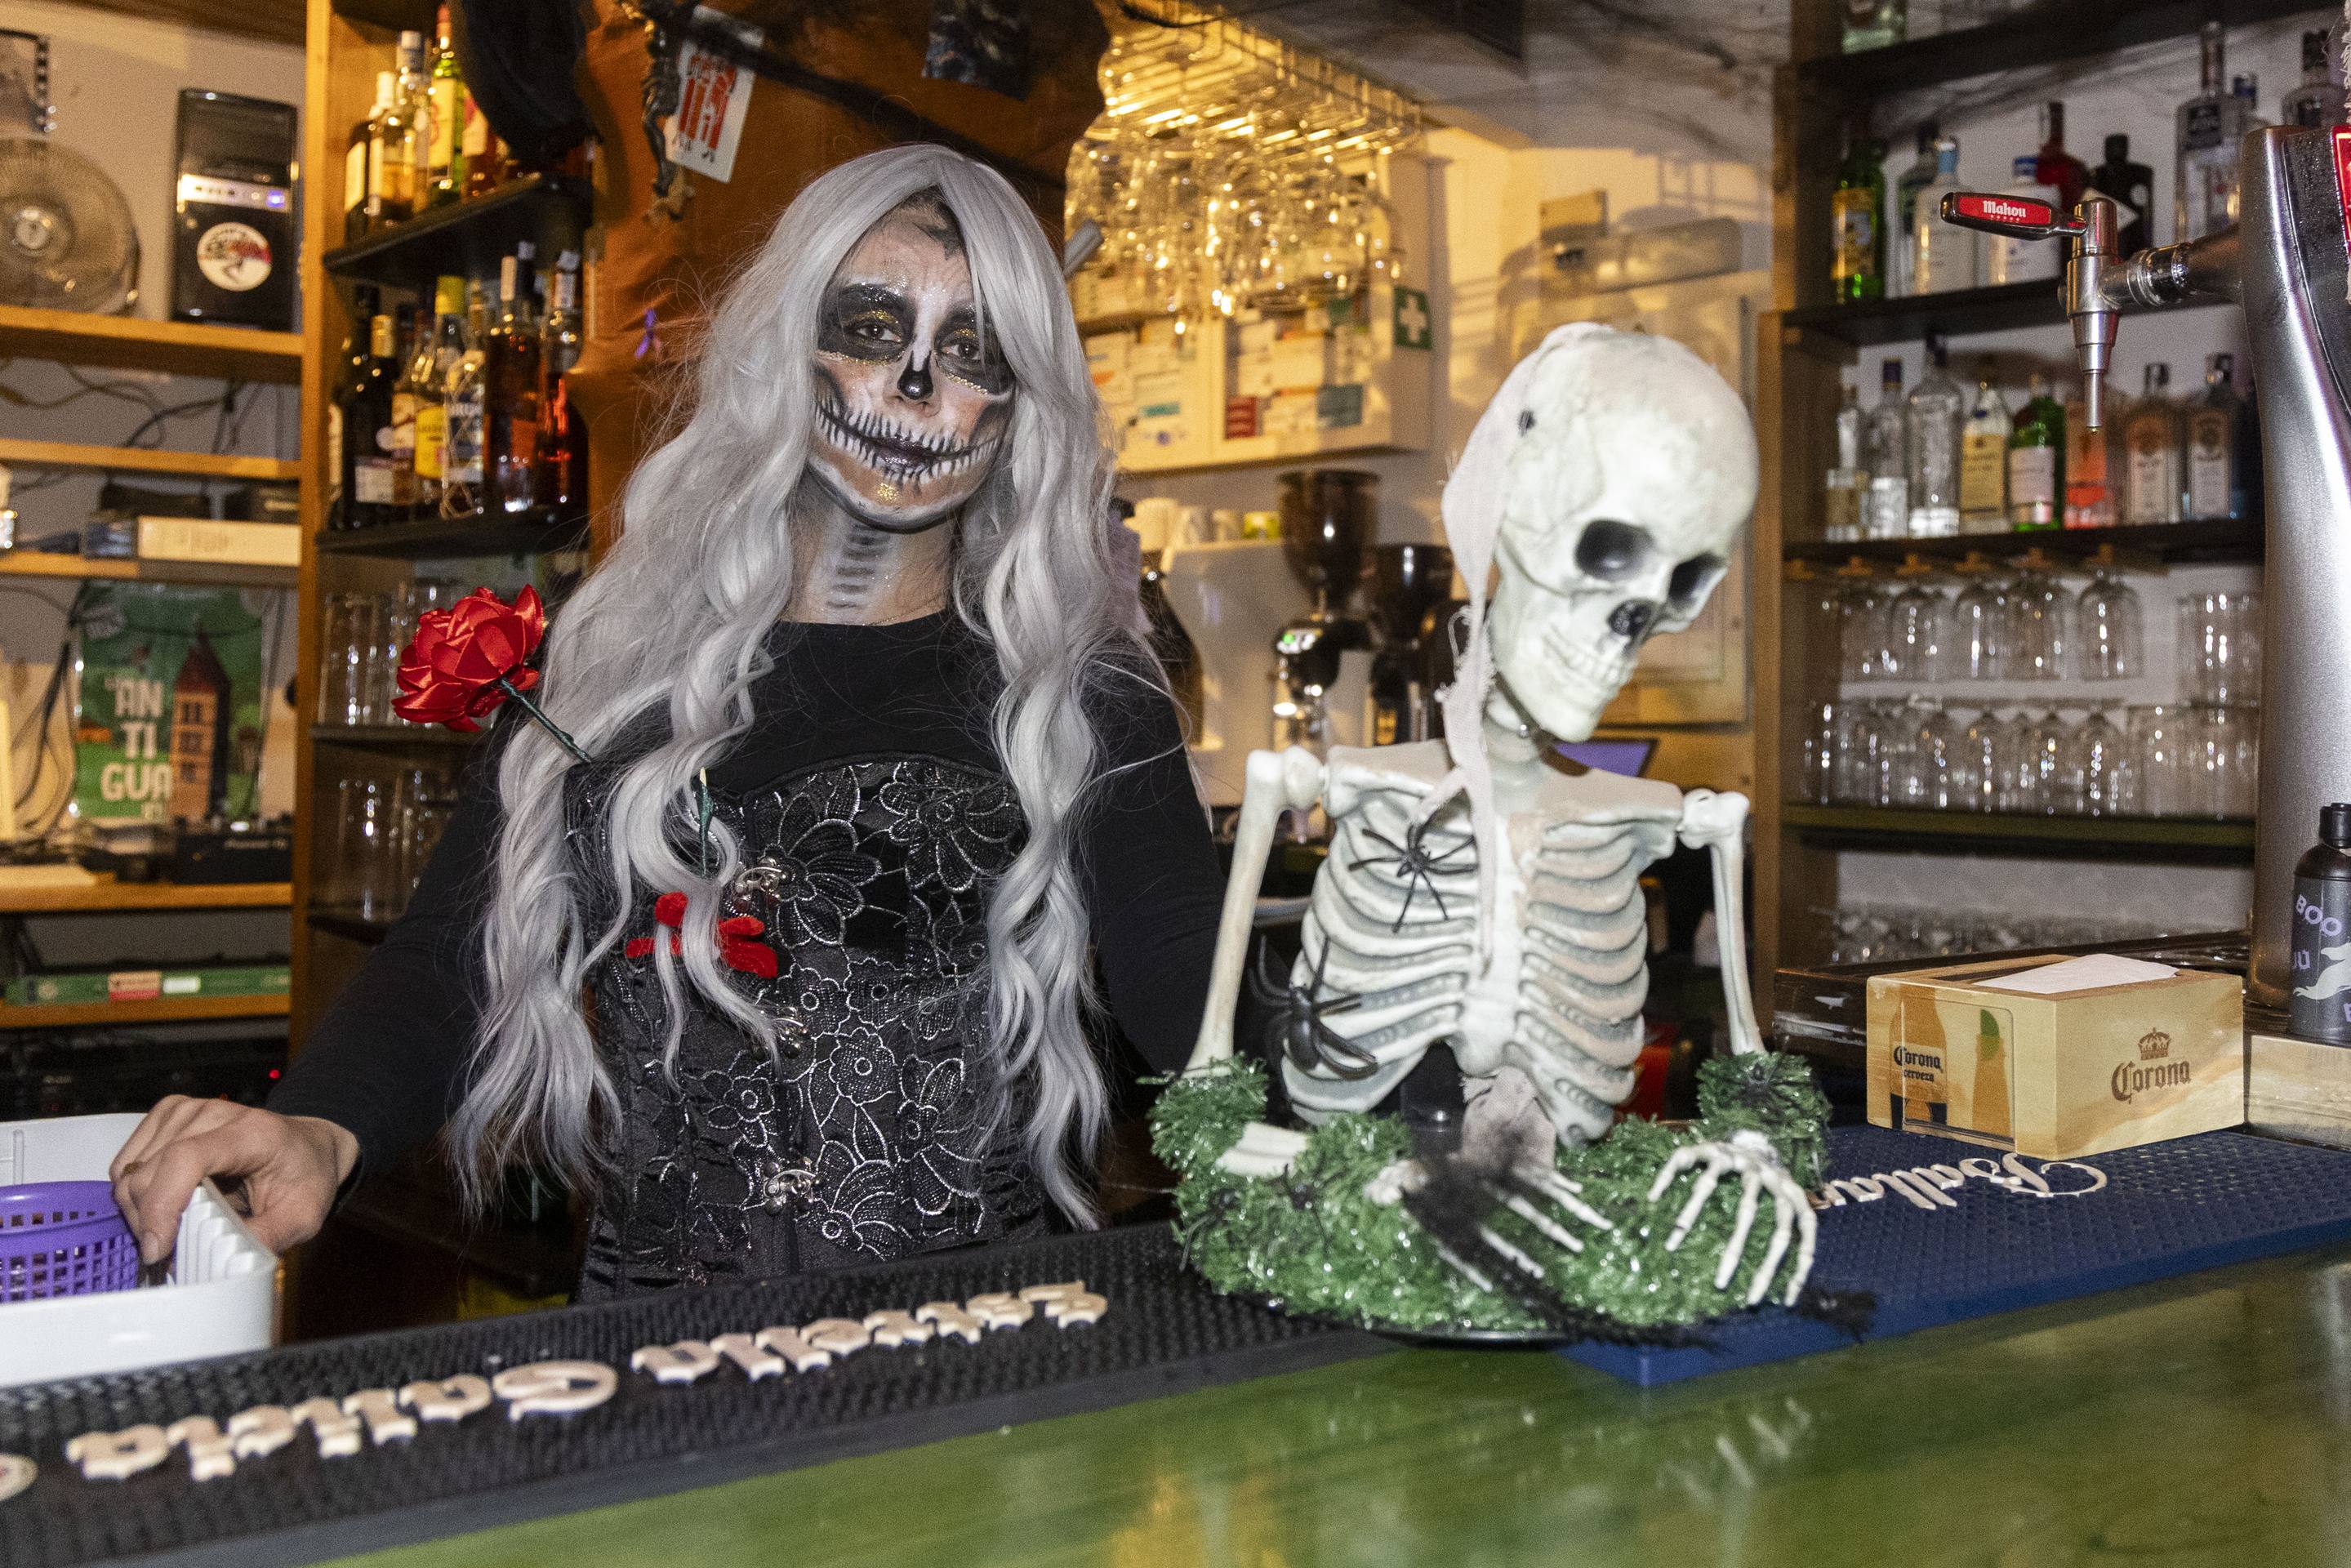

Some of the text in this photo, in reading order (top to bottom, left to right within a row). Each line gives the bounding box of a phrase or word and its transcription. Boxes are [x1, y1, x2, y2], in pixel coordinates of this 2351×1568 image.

[1983, 200, 2026, 218] Mahou
[121, 721, 158, 760] TI
[100, 763, 174, 801] GUA
[2296, 894, 2342, 937] BOO
[1893, 1045, 1942, 1071] Corona
[2111, 1061, 2192, 1105] Corona
[65, 1359, 619, 1482] Galicia
